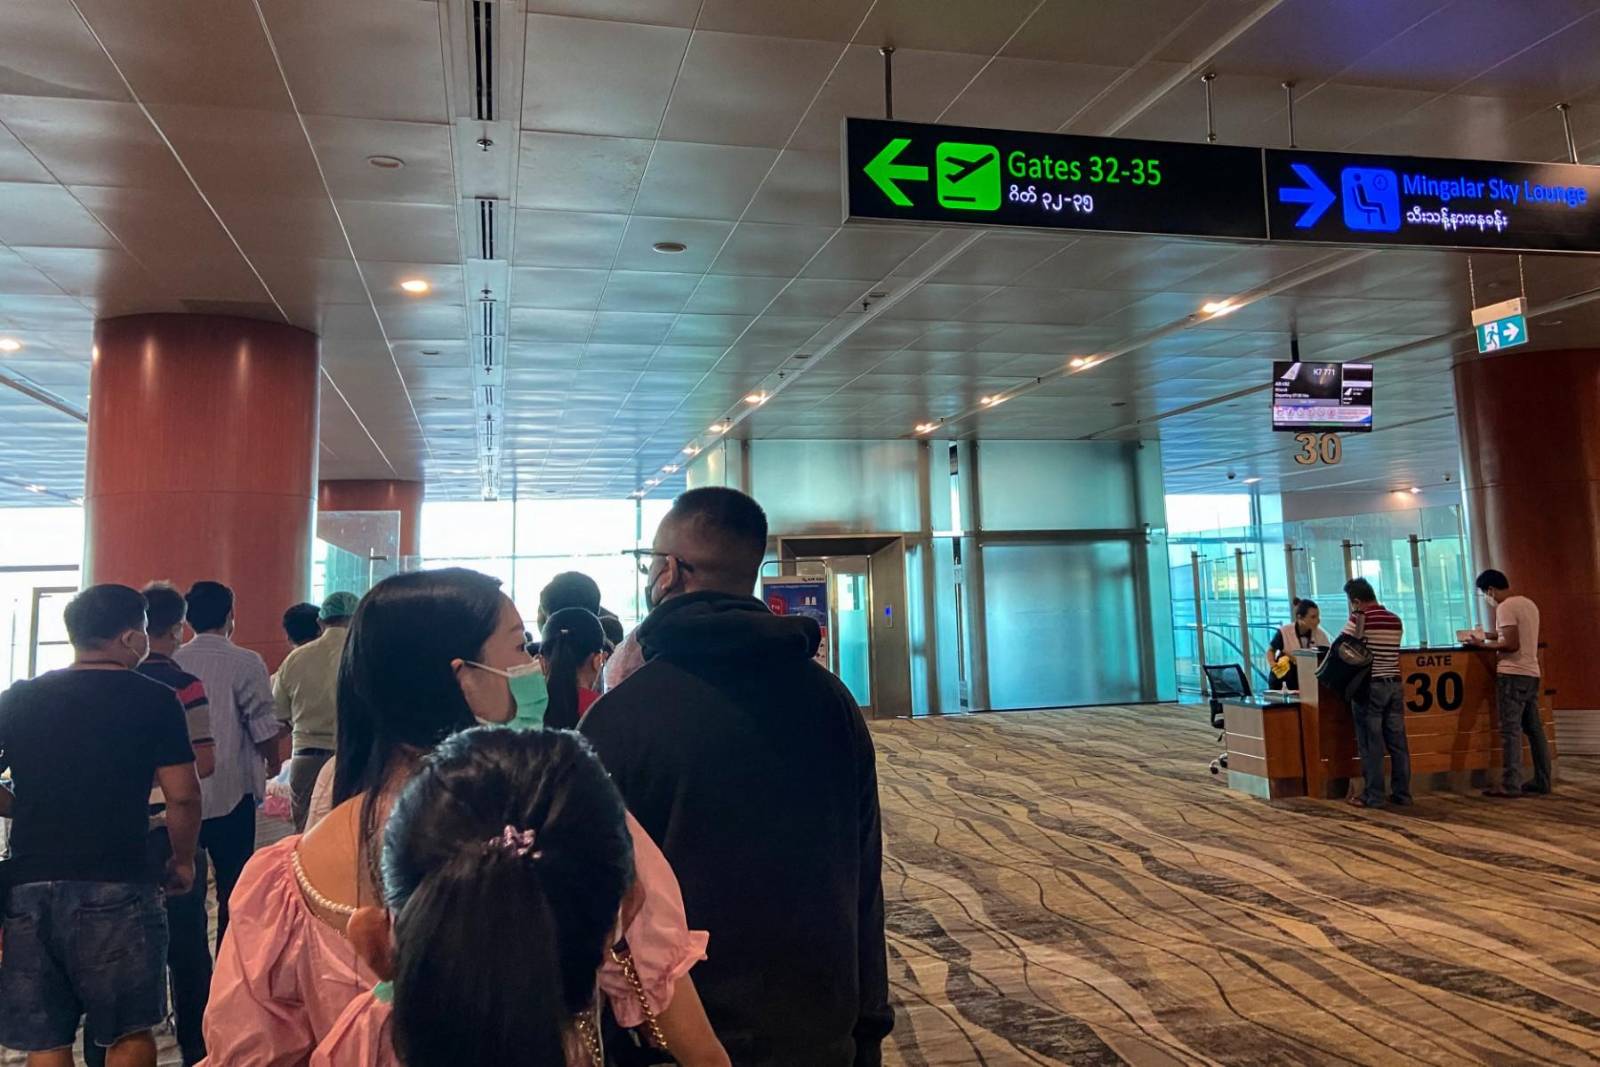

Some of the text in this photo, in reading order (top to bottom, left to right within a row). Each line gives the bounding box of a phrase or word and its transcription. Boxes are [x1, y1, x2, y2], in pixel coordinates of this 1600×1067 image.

[1007, 150, 1162, 185] Gates 32-35
[1008, 184, 1038, 203] ဂိတ်
[1402, 174, 1588, 208] Mingalar Sky Lounge
[1294, 432, 1342, 465] 30
[1416, 654, 1452, 667] GATE
[1406, 671, 1464, 713] 30
